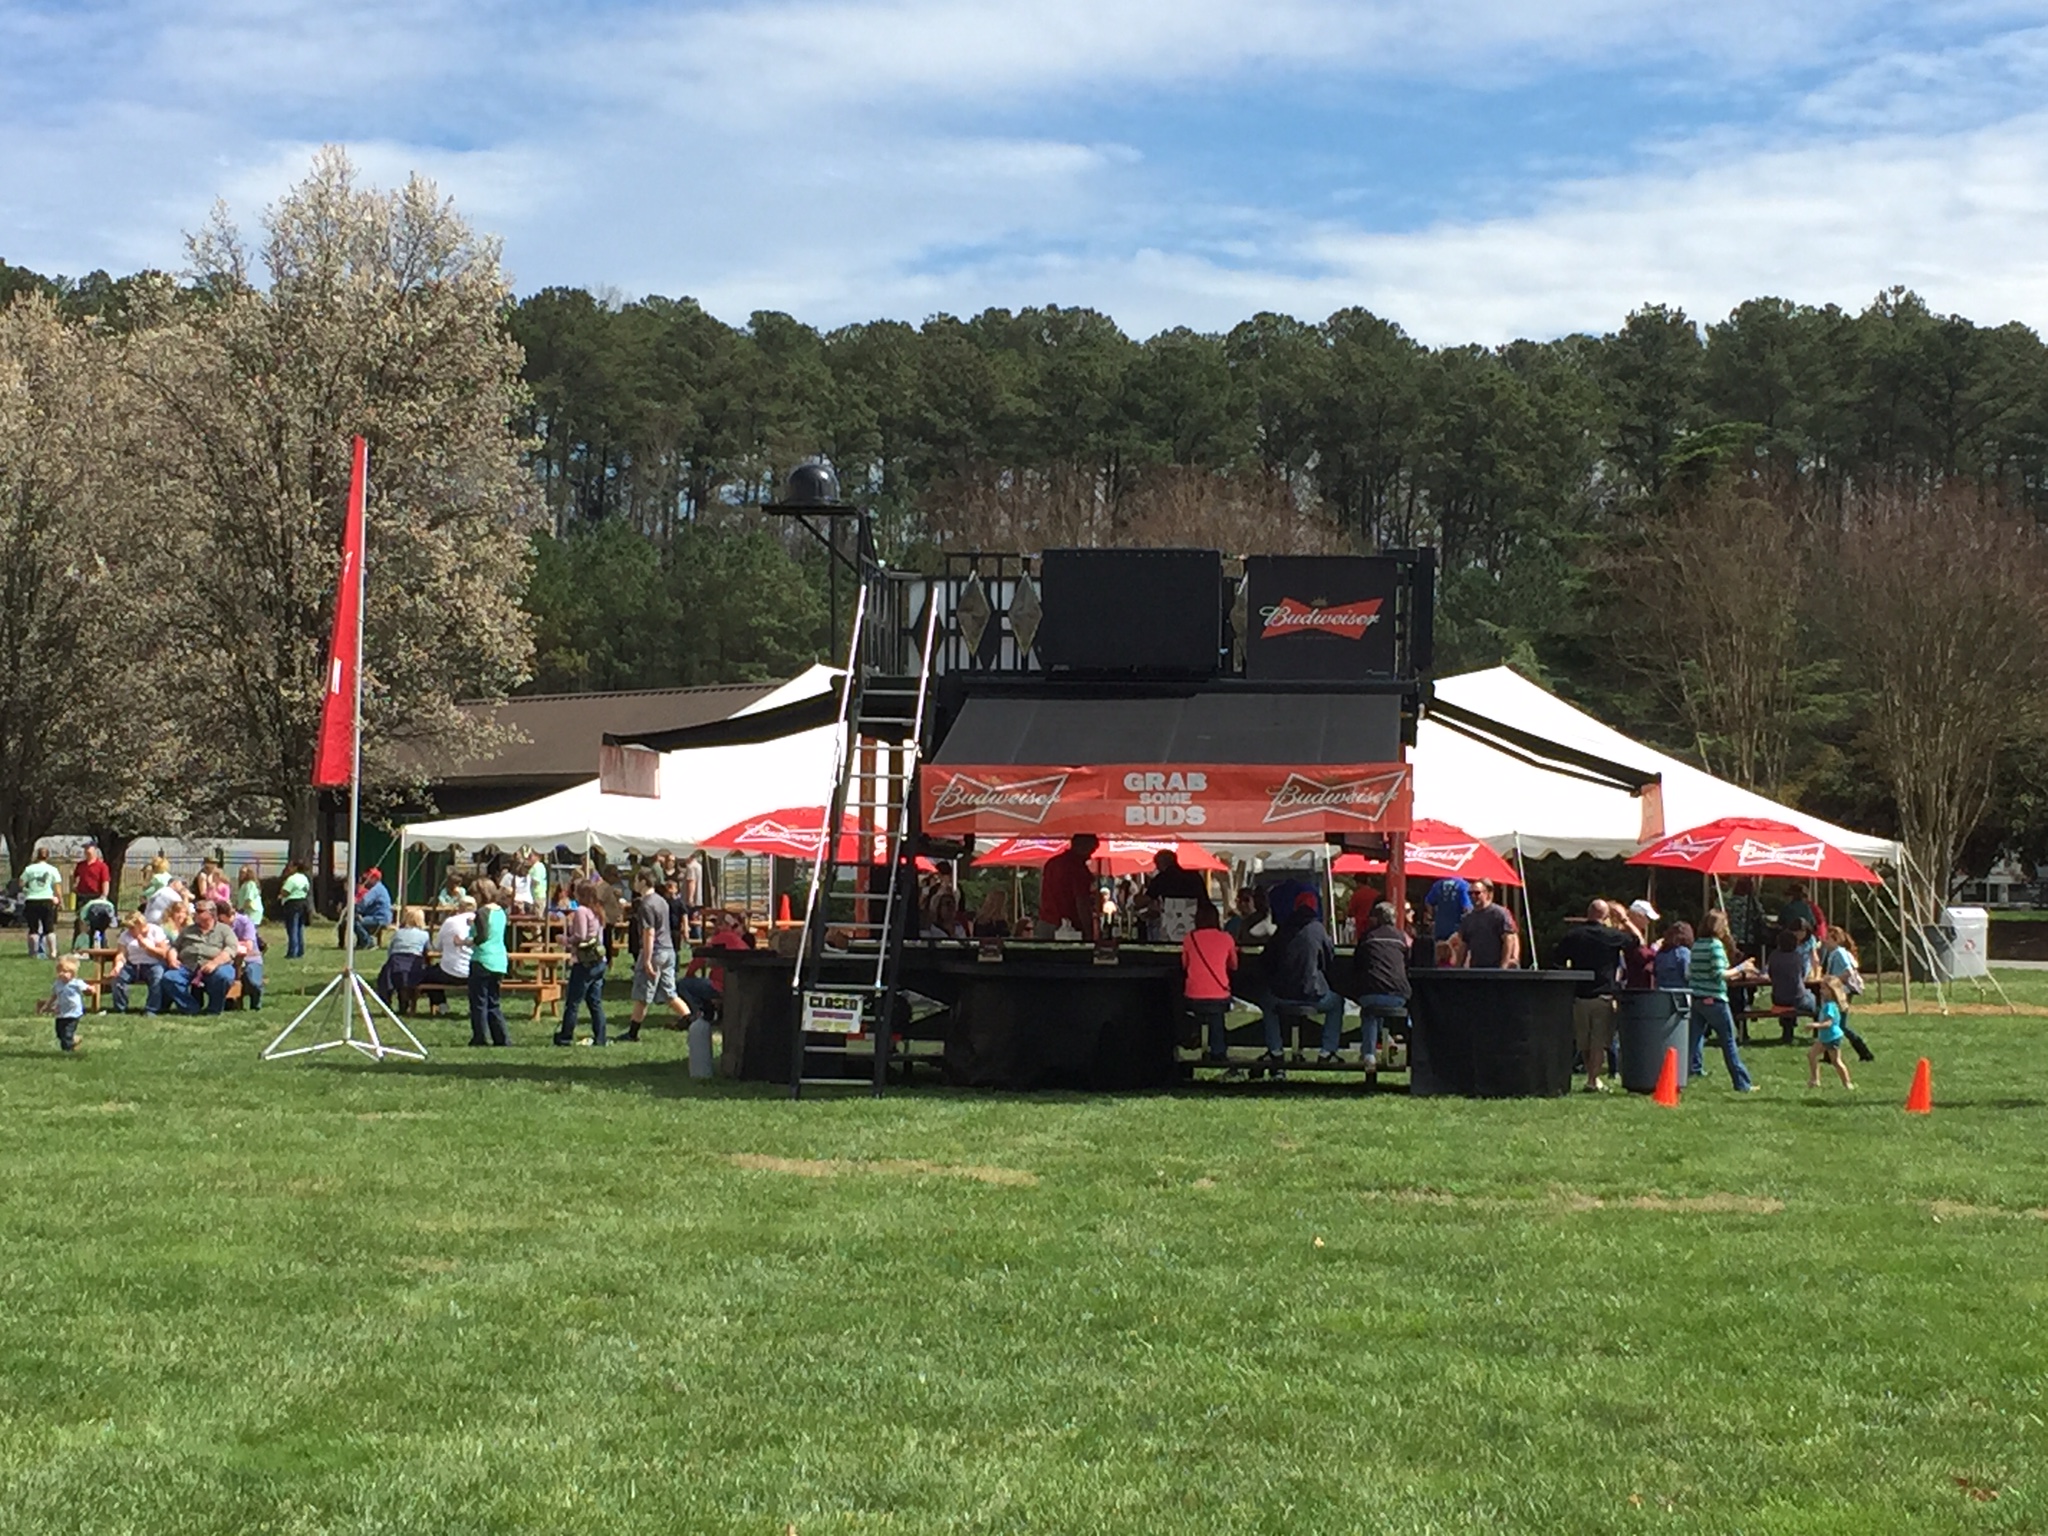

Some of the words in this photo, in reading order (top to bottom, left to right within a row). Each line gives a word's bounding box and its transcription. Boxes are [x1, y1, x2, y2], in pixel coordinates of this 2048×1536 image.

[1259, 605, 1380, 627] Budweiser
[1123, 771, 1208, 792] GRAB
[930, 784, 1061, 808] Budweiser
[1139, 792, 1193, 805] SOME
[1265, 784, 1399, 808] Budweiser
[1125, 805, 1207, 826] BUDS
[809, 995, 859, 1011] CLOSED
